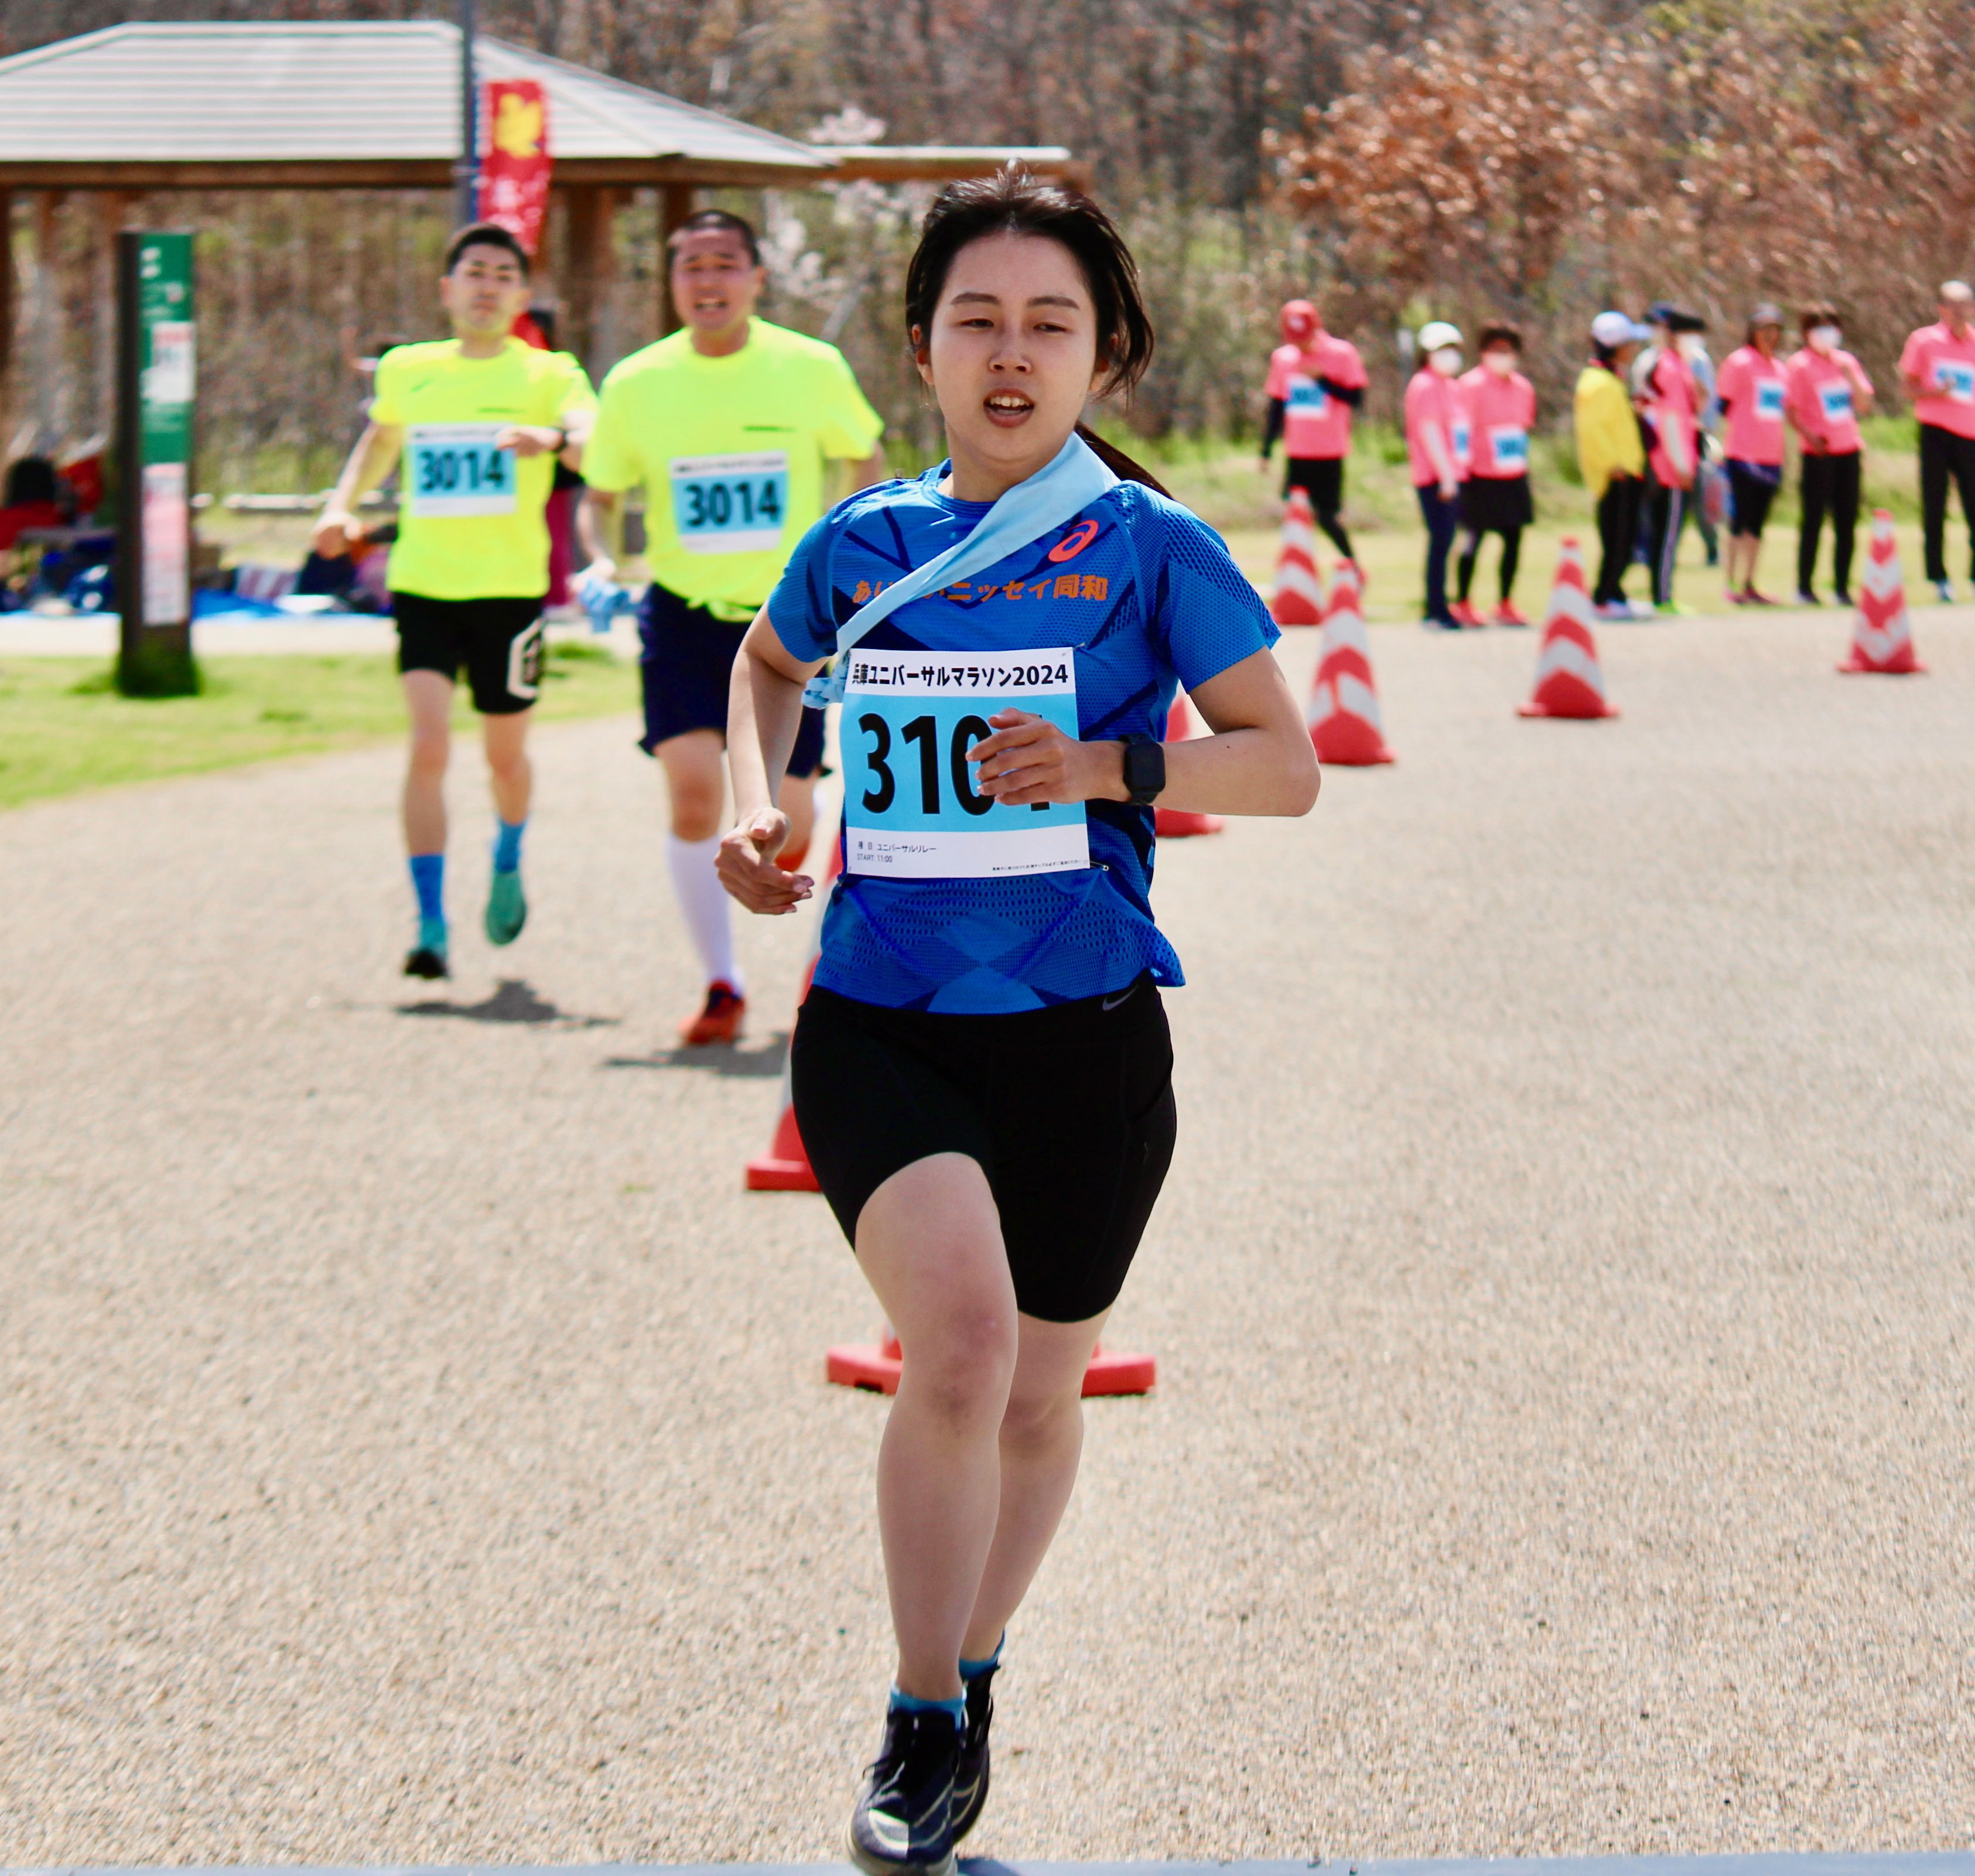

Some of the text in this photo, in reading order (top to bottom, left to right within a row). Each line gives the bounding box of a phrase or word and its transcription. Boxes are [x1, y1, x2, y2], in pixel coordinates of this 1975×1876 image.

[420, 450, 504, 491] 3014
[684, 480, 781, 527] 3014
[852, 573, 1108, 604] あニッセイ同和
[852, 663, 1068, 687] 兵庫ユニバーサルマラソン2024
[858, 713, 1050, 815] 310
[857, 853, 874, 862] START
